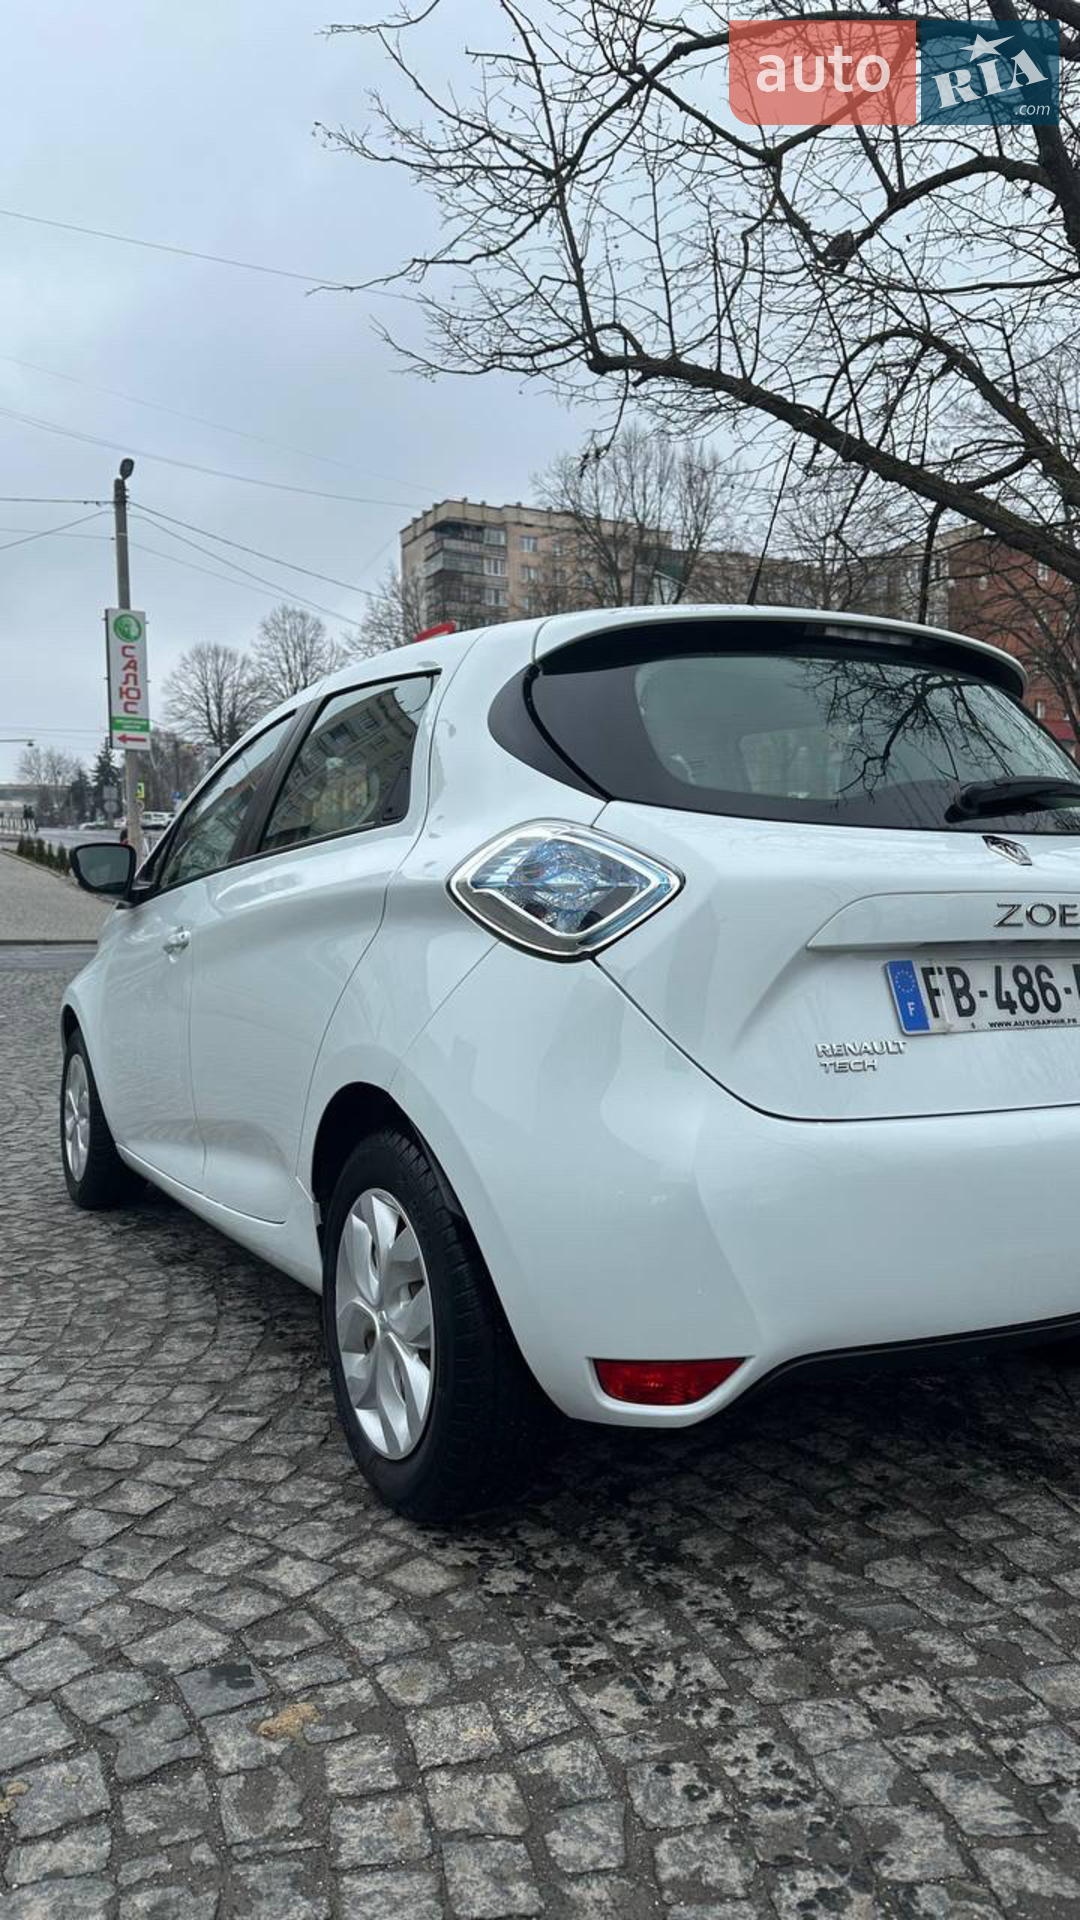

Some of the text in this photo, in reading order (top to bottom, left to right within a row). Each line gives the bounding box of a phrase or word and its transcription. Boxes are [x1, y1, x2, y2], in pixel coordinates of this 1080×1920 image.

[120, 645, 141, 714] САЛЮС
[994, 903, 1080, 927] ZOE
[907, 1002, 916, 1016] F
[815, 1040, 906, 1058] RENAULT
[819, 1060, 877, 1074] TECH
